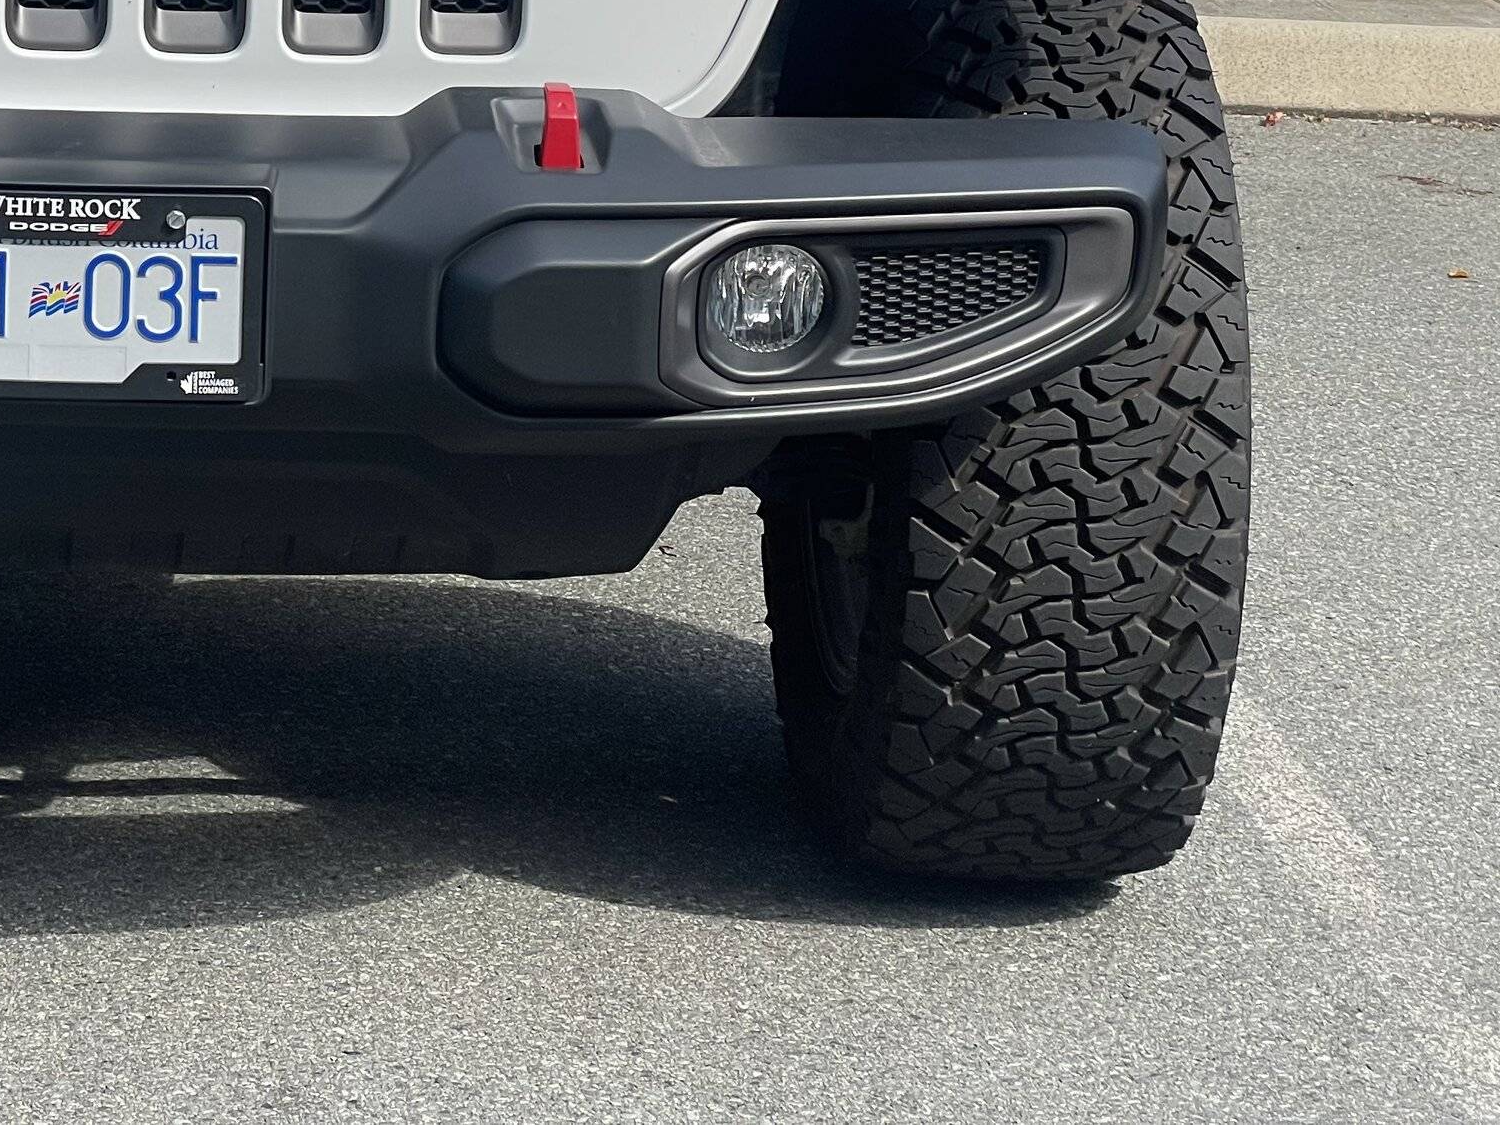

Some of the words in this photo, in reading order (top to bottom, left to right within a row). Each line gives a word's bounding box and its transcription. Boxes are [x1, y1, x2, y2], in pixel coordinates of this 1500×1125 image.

[68, 197, 141, 220] ROCK
[9, 221, 109, 233] DODGE
[82, 251, 238, 344] 03F
